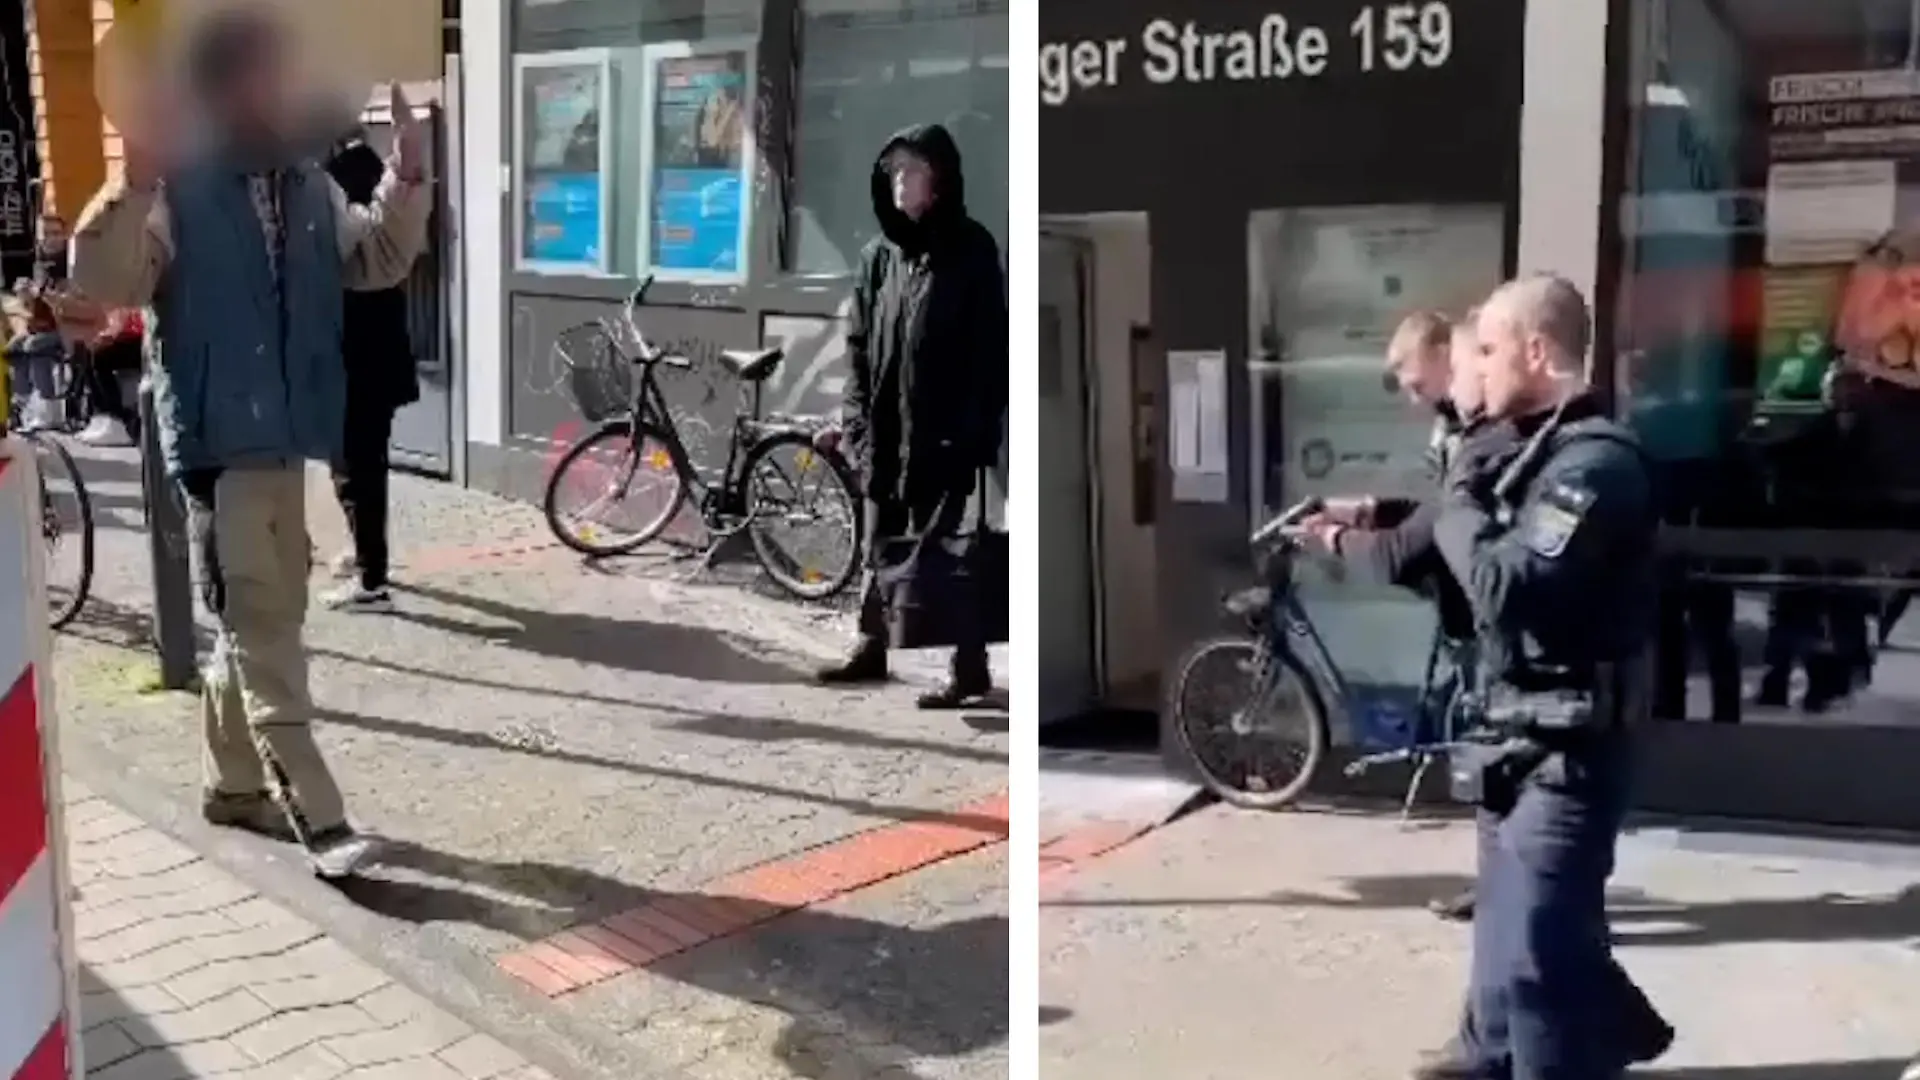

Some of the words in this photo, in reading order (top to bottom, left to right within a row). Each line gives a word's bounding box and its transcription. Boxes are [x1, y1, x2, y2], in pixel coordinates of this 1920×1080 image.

[1039, 38, 1126, 105] ger
[1142, 13, 1329, 83] Straße
[1350, 2, 1452, 72] 159
